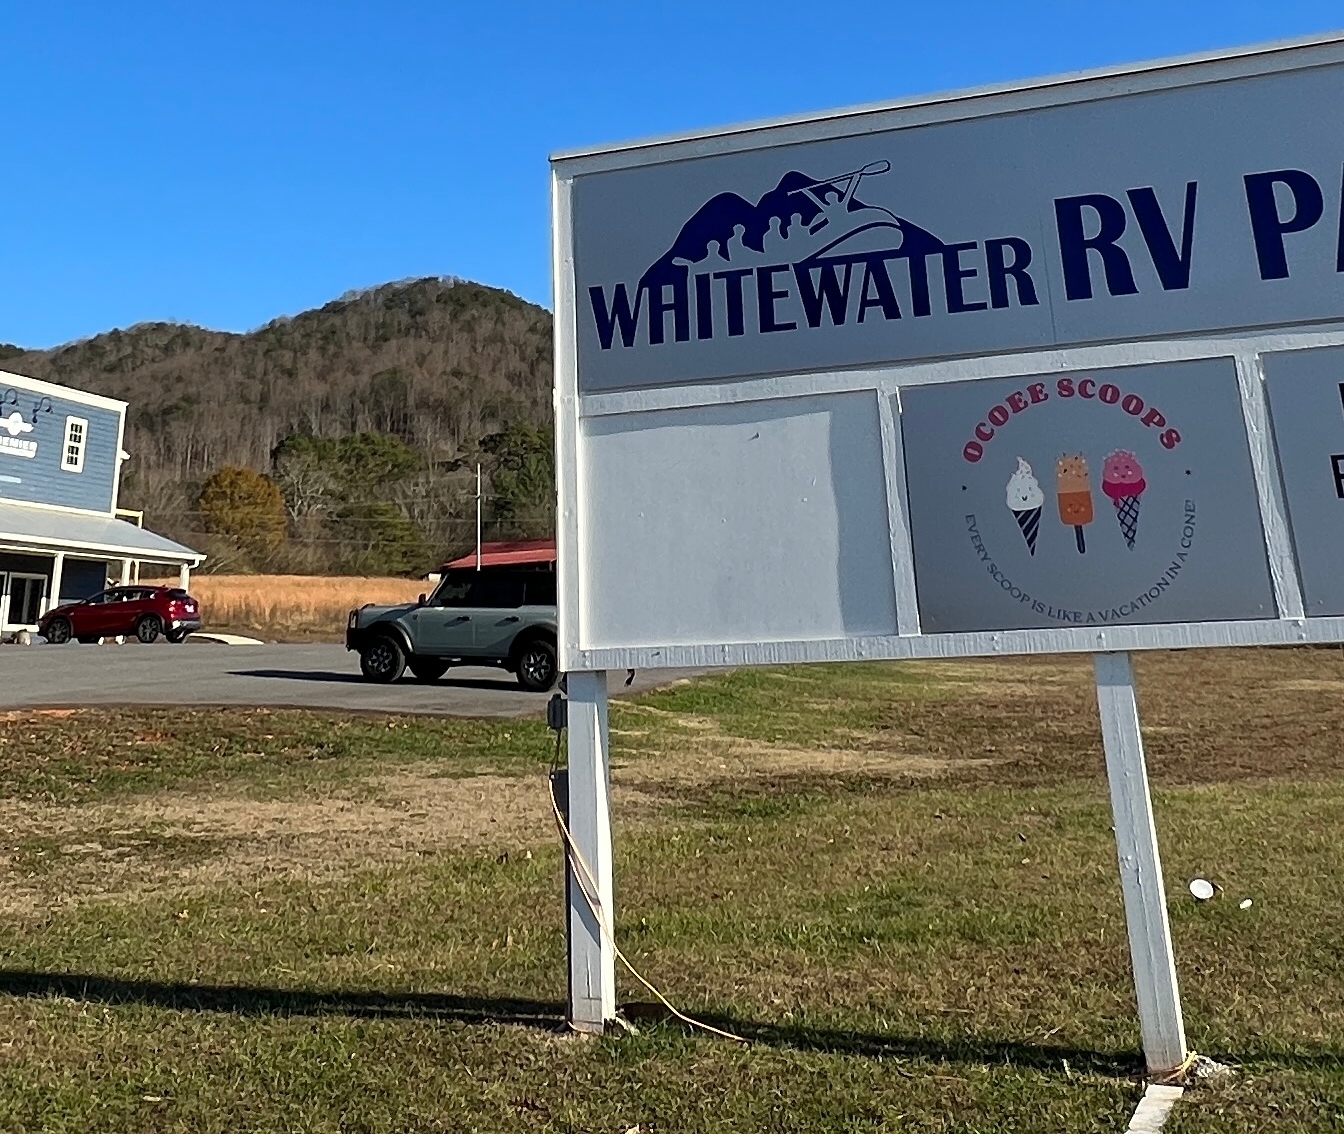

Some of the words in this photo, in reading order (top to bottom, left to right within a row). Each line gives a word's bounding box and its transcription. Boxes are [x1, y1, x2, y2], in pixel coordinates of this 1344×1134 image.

[588, 237, 1040, 351] WHITEWATER
[1053, 181, 1198, 302] RV
[962, 382, 1049, 463] OCOEE
[1057, 378, 1182, 450] SCOOPS
[965, 513, 992, 563] EVERY
[986, 563, 1031, 604] SCOOP
[1031, 599, 1046, 614] IS
[1047, 606, 1083, 623] LIKE
[1085, 612, 1096, 624] A
[1098, 576, 1170, 622] VACATION
[1165, 561, 1182, 581] IN
[1176, 551, 1188, 563] A
